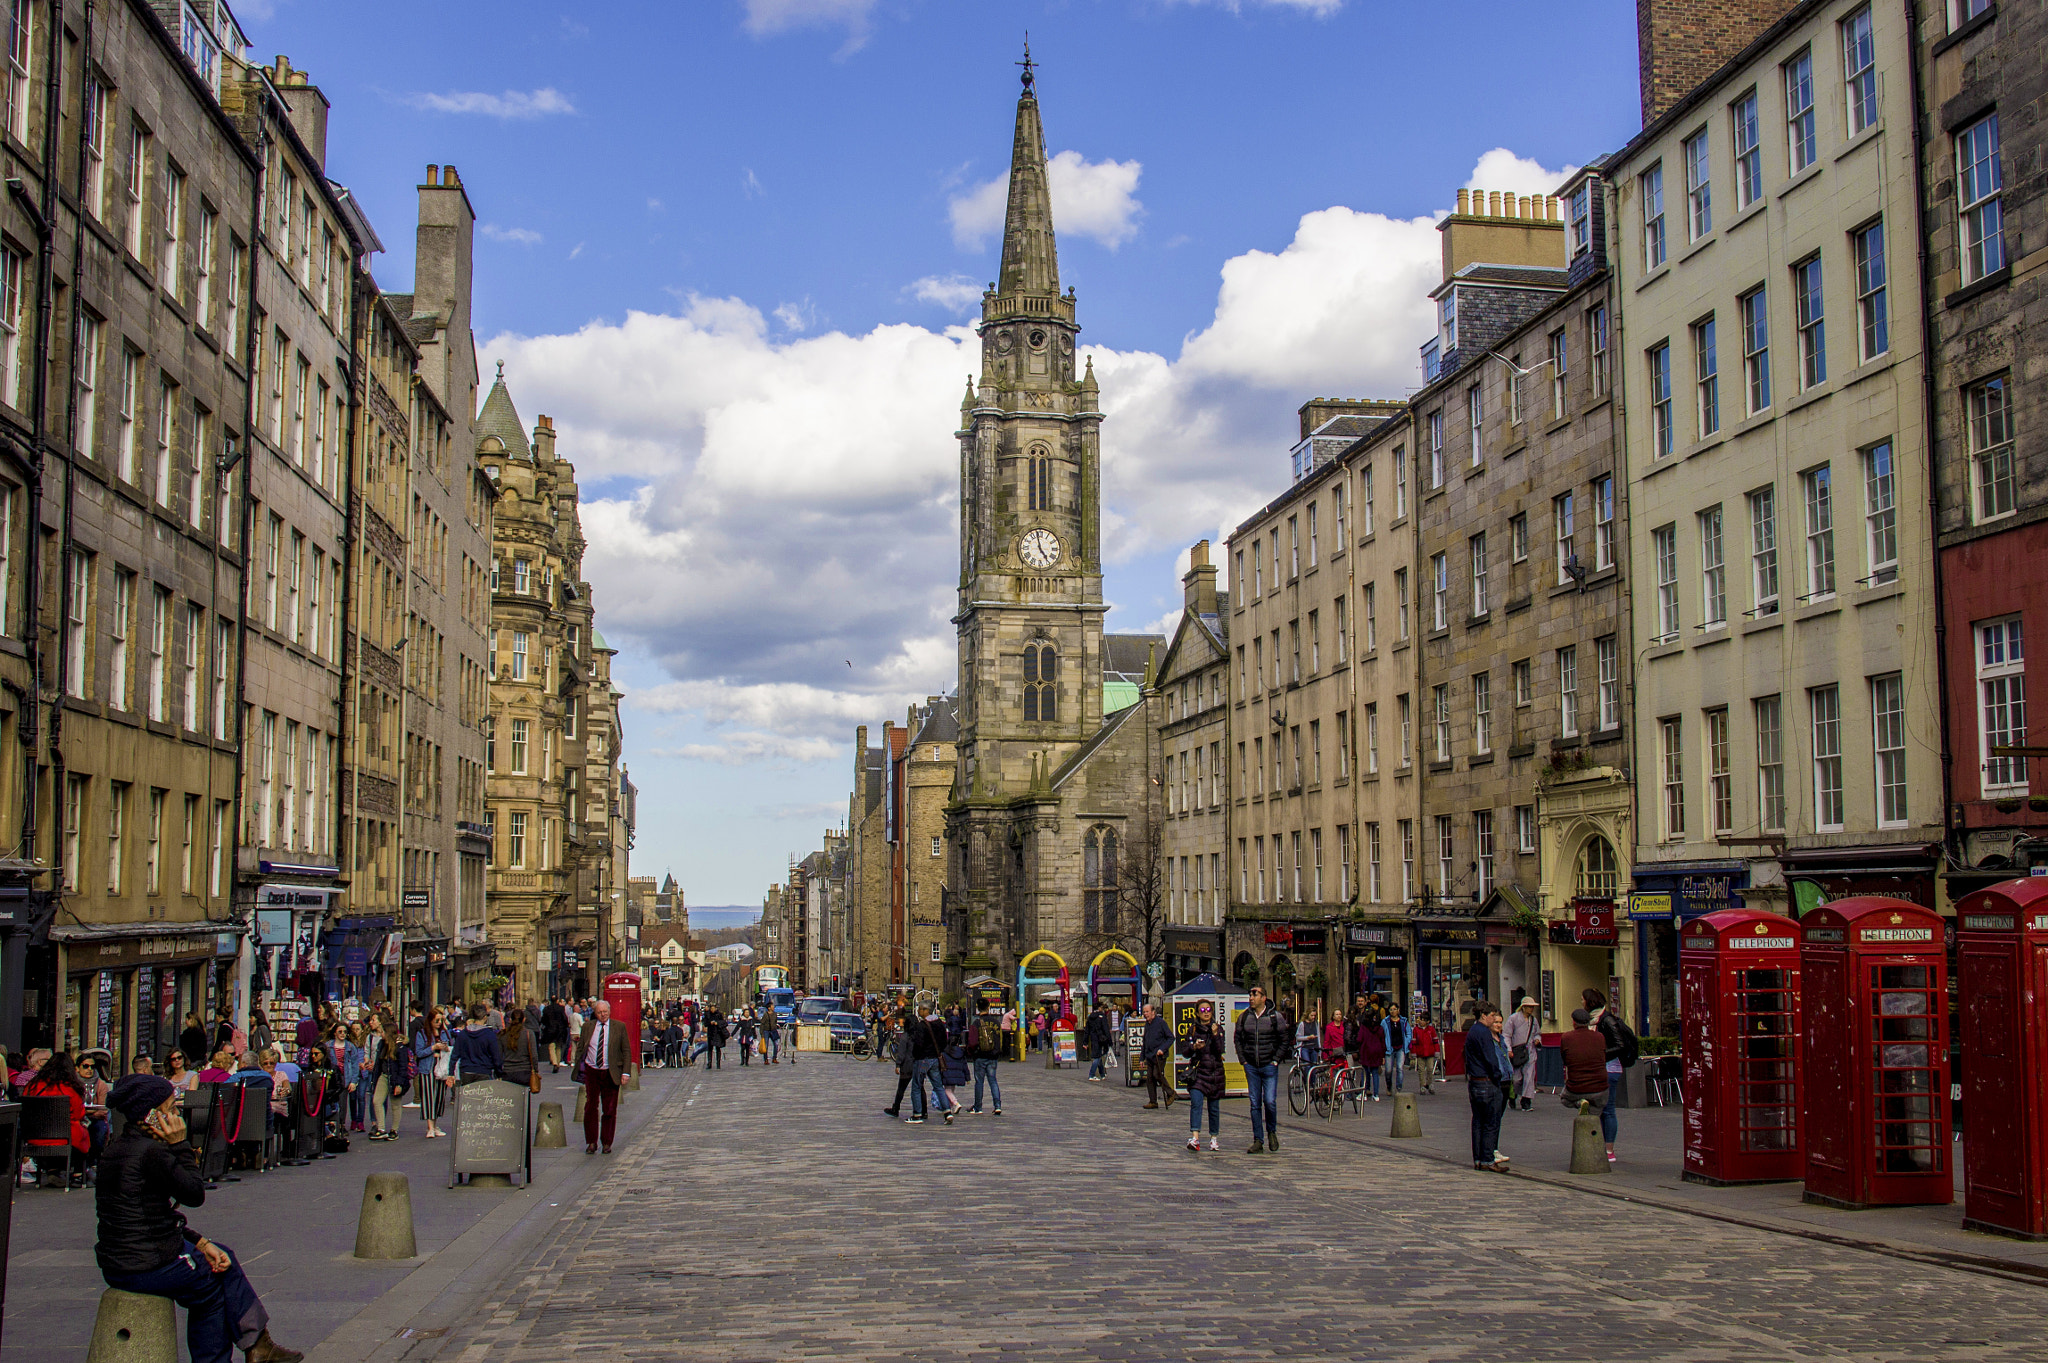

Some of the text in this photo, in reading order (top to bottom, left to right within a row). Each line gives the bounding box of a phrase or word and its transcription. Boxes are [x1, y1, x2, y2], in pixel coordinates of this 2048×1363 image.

[1579, 904, 1610, 914] coffee
[1966, 916, 2014, 929] TELEPHONE
[1351, 928, 1385, 943] WARHAMMER
[1580, 926, 1611, 936] house
[1864, 929, 1930, 940] TELEPHONE
[140, 938, 153, 955] The
[153, 937, 176, 958] Whisky
[1733, 938, 1791, 948] TELEPHONE
[1182, 1007, 1197, 1021] FR
[1128, 1027, 1145, 1037] PU
